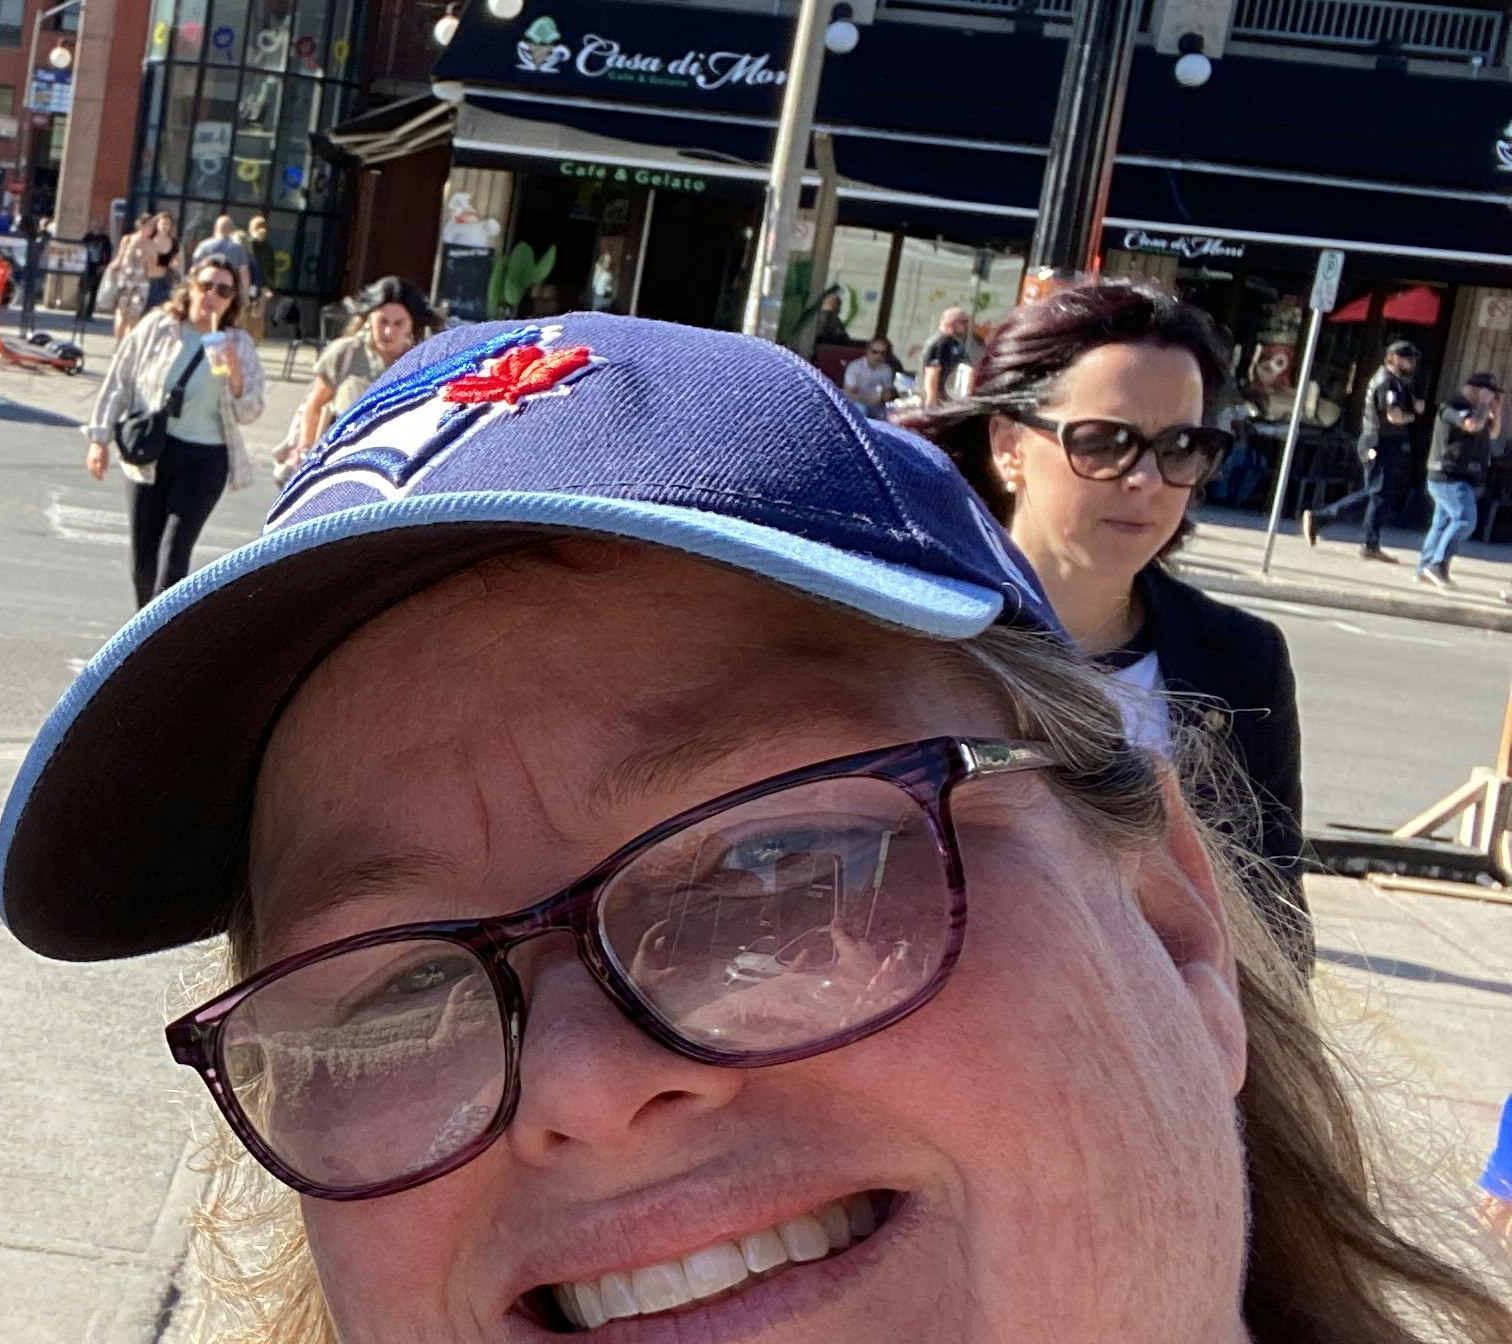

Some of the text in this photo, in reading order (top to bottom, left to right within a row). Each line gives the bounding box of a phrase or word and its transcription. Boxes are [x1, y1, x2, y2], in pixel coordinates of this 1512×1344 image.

[576, 33, 788, 90] Casa di Mor
[635, 170, 706, 192] Gelato
